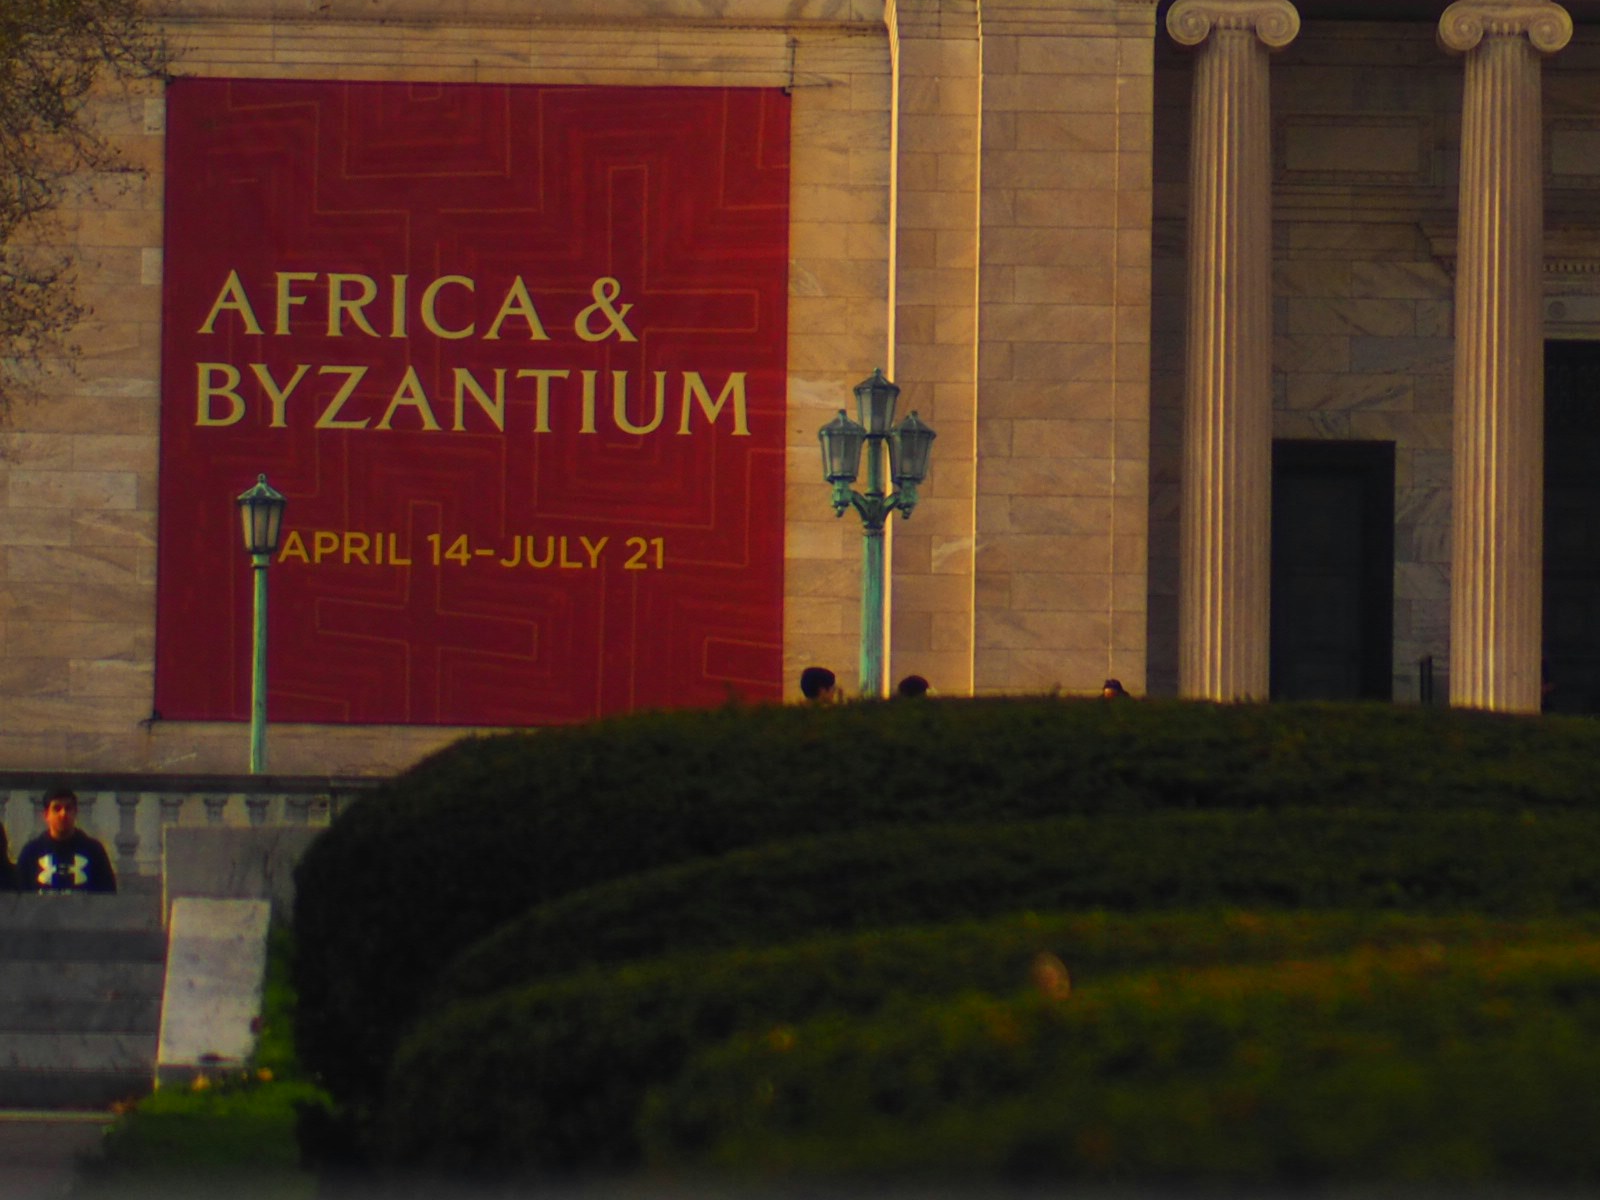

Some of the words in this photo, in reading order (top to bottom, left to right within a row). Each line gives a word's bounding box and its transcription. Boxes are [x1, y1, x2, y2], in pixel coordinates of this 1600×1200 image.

[197, 268, 551, 341] AFRICA
[573, 275, 639, 343] &
[194, 361, 752, 437] BYZANTIUM
[277, 530, 412, 566] APRIL
[623, 536, 664, 570] 21
